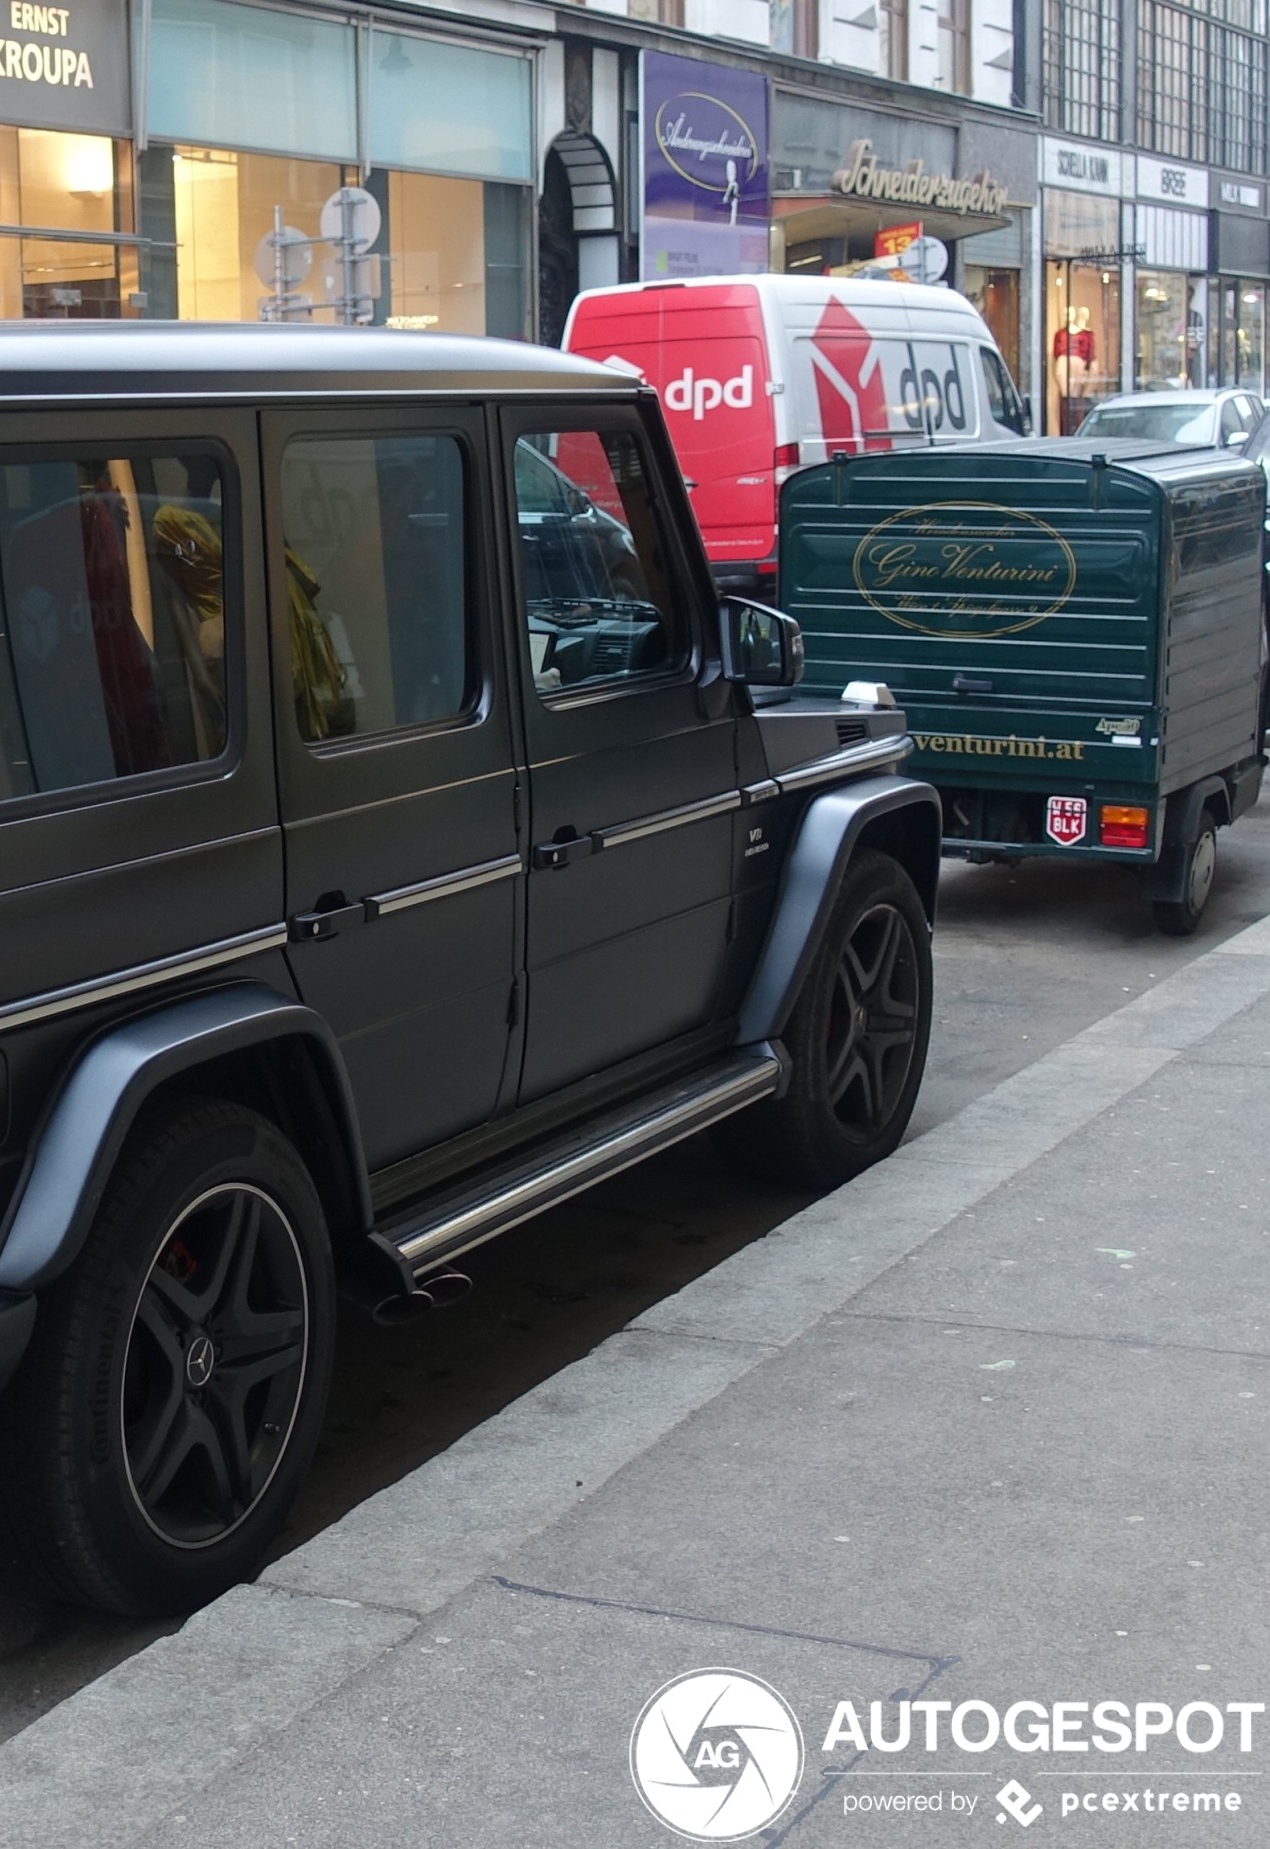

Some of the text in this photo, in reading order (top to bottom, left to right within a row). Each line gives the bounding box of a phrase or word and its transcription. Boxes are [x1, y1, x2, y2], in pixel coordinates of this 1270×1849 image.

[11, 1, 69, 36] ERNST
[664, 364, 752, 420] dpd
[900, 342, 966, 445] dpd
[869, 543, 1059, 587] Gino Venturini
[914, 734, 1085, 760] venturini.at
[1053, 817, 1080, 834] BLK
